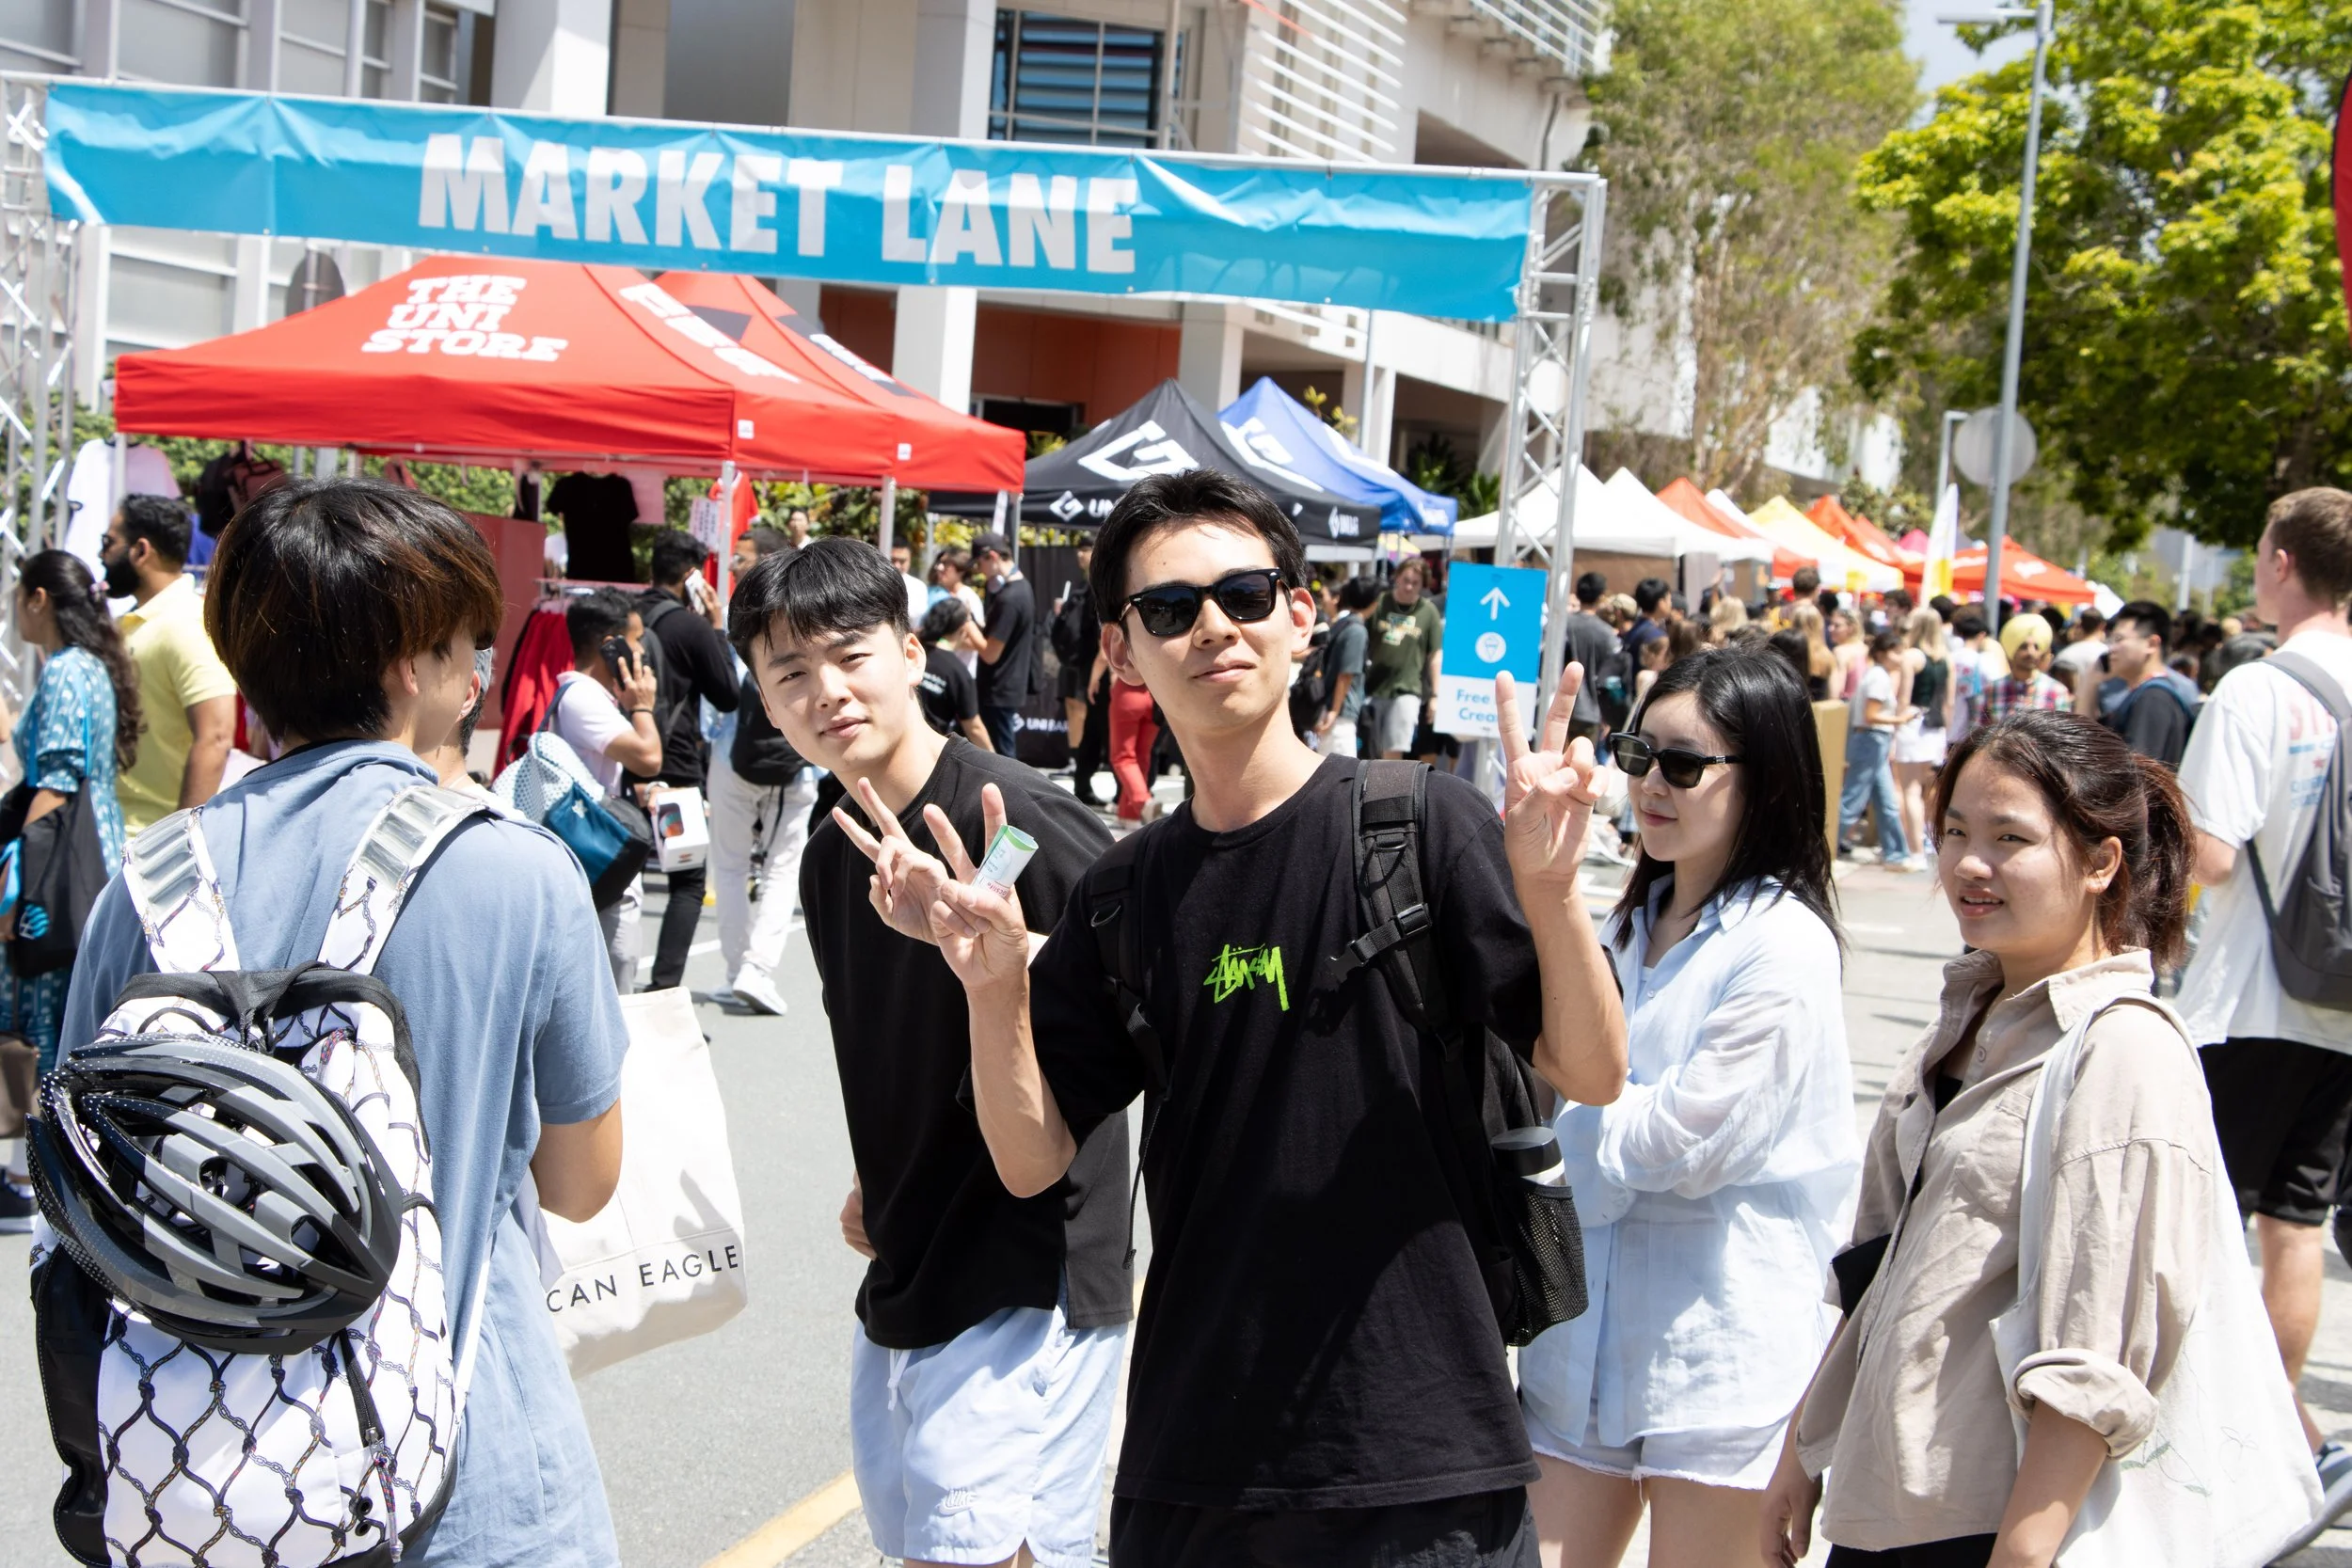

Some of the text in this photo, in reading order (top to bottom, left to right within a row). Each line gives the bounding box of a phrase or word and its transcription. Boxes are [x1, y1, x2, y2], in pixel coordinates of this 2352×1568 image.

[418, 133, 1138, 274] MARKET LANE
[406, 275, 528, 306] THE
[387, 302, 512, 332] UNI
[361, 328, 569, 362] STORE
[1456, 689, 1490, 704] Free
[1458, 707, 1497, 723] Crea
[638, 1244, 739, 1288] EAGLE
